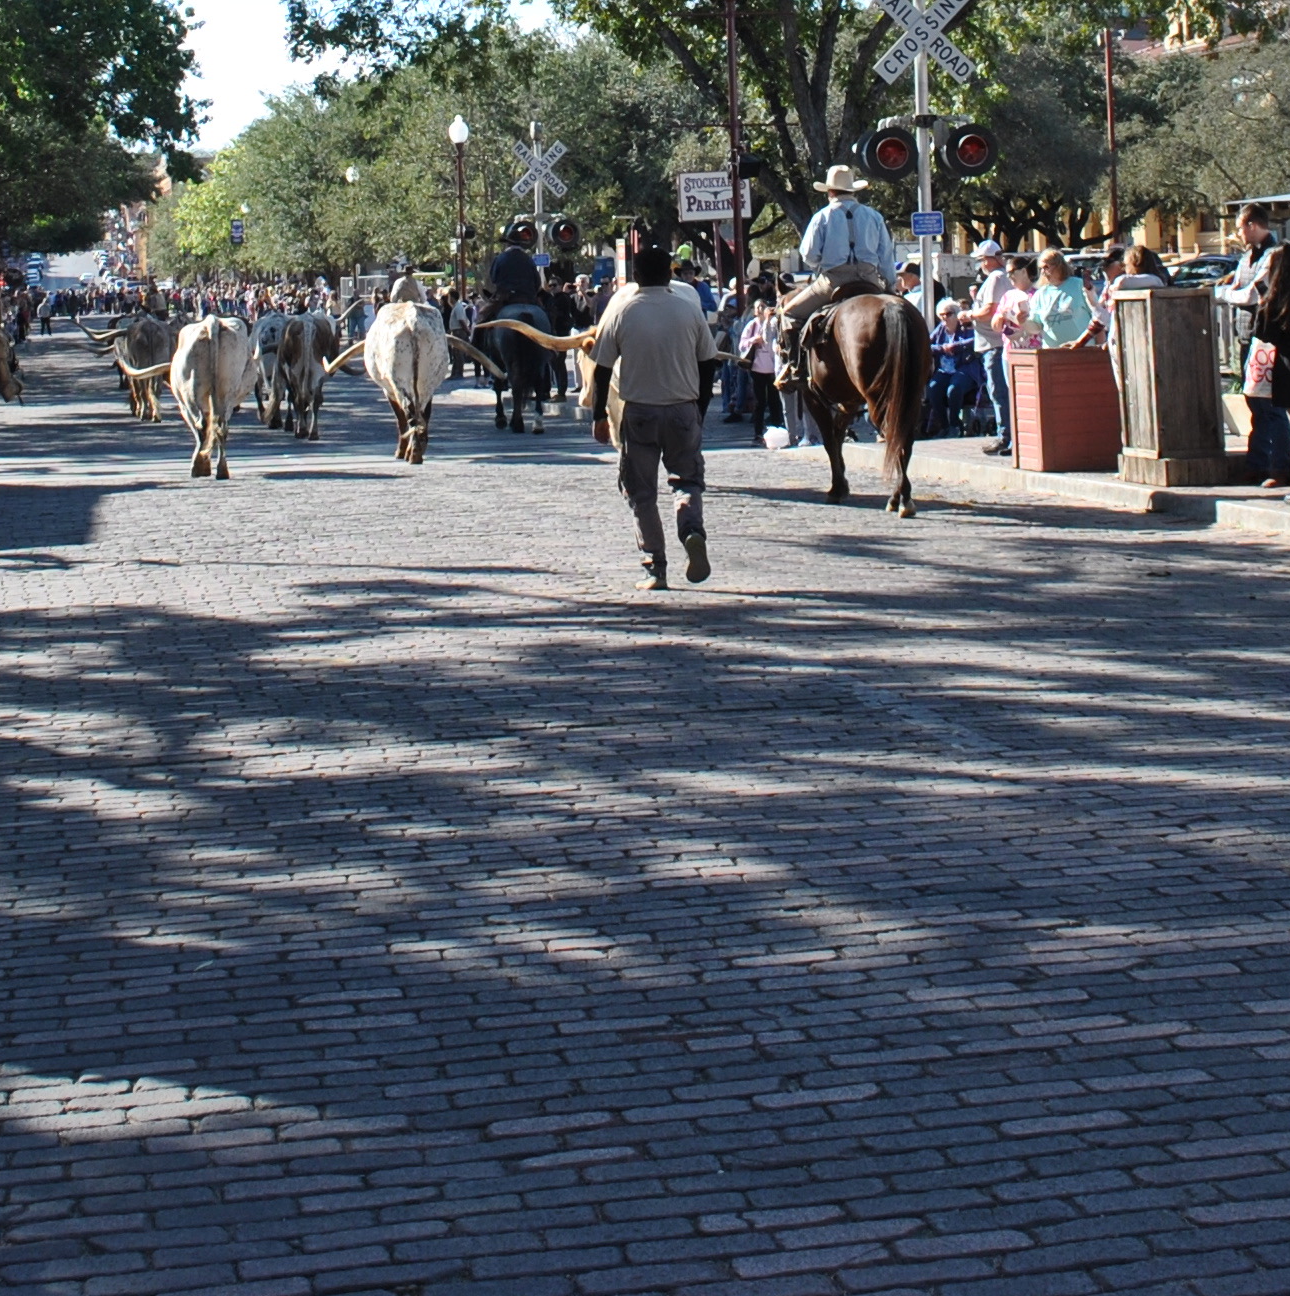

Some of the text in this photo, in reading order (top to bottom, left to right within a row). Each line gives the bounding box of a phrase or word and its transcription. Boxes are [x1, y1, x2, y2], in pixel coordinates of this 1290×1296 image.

[930, 37, 969, 77] ROAD
[515, 144, 564, 194] RAIL ROAD
[517, 145, 563, 194] CROSSING
[684, 177, 746, 192] STOCKYAS
